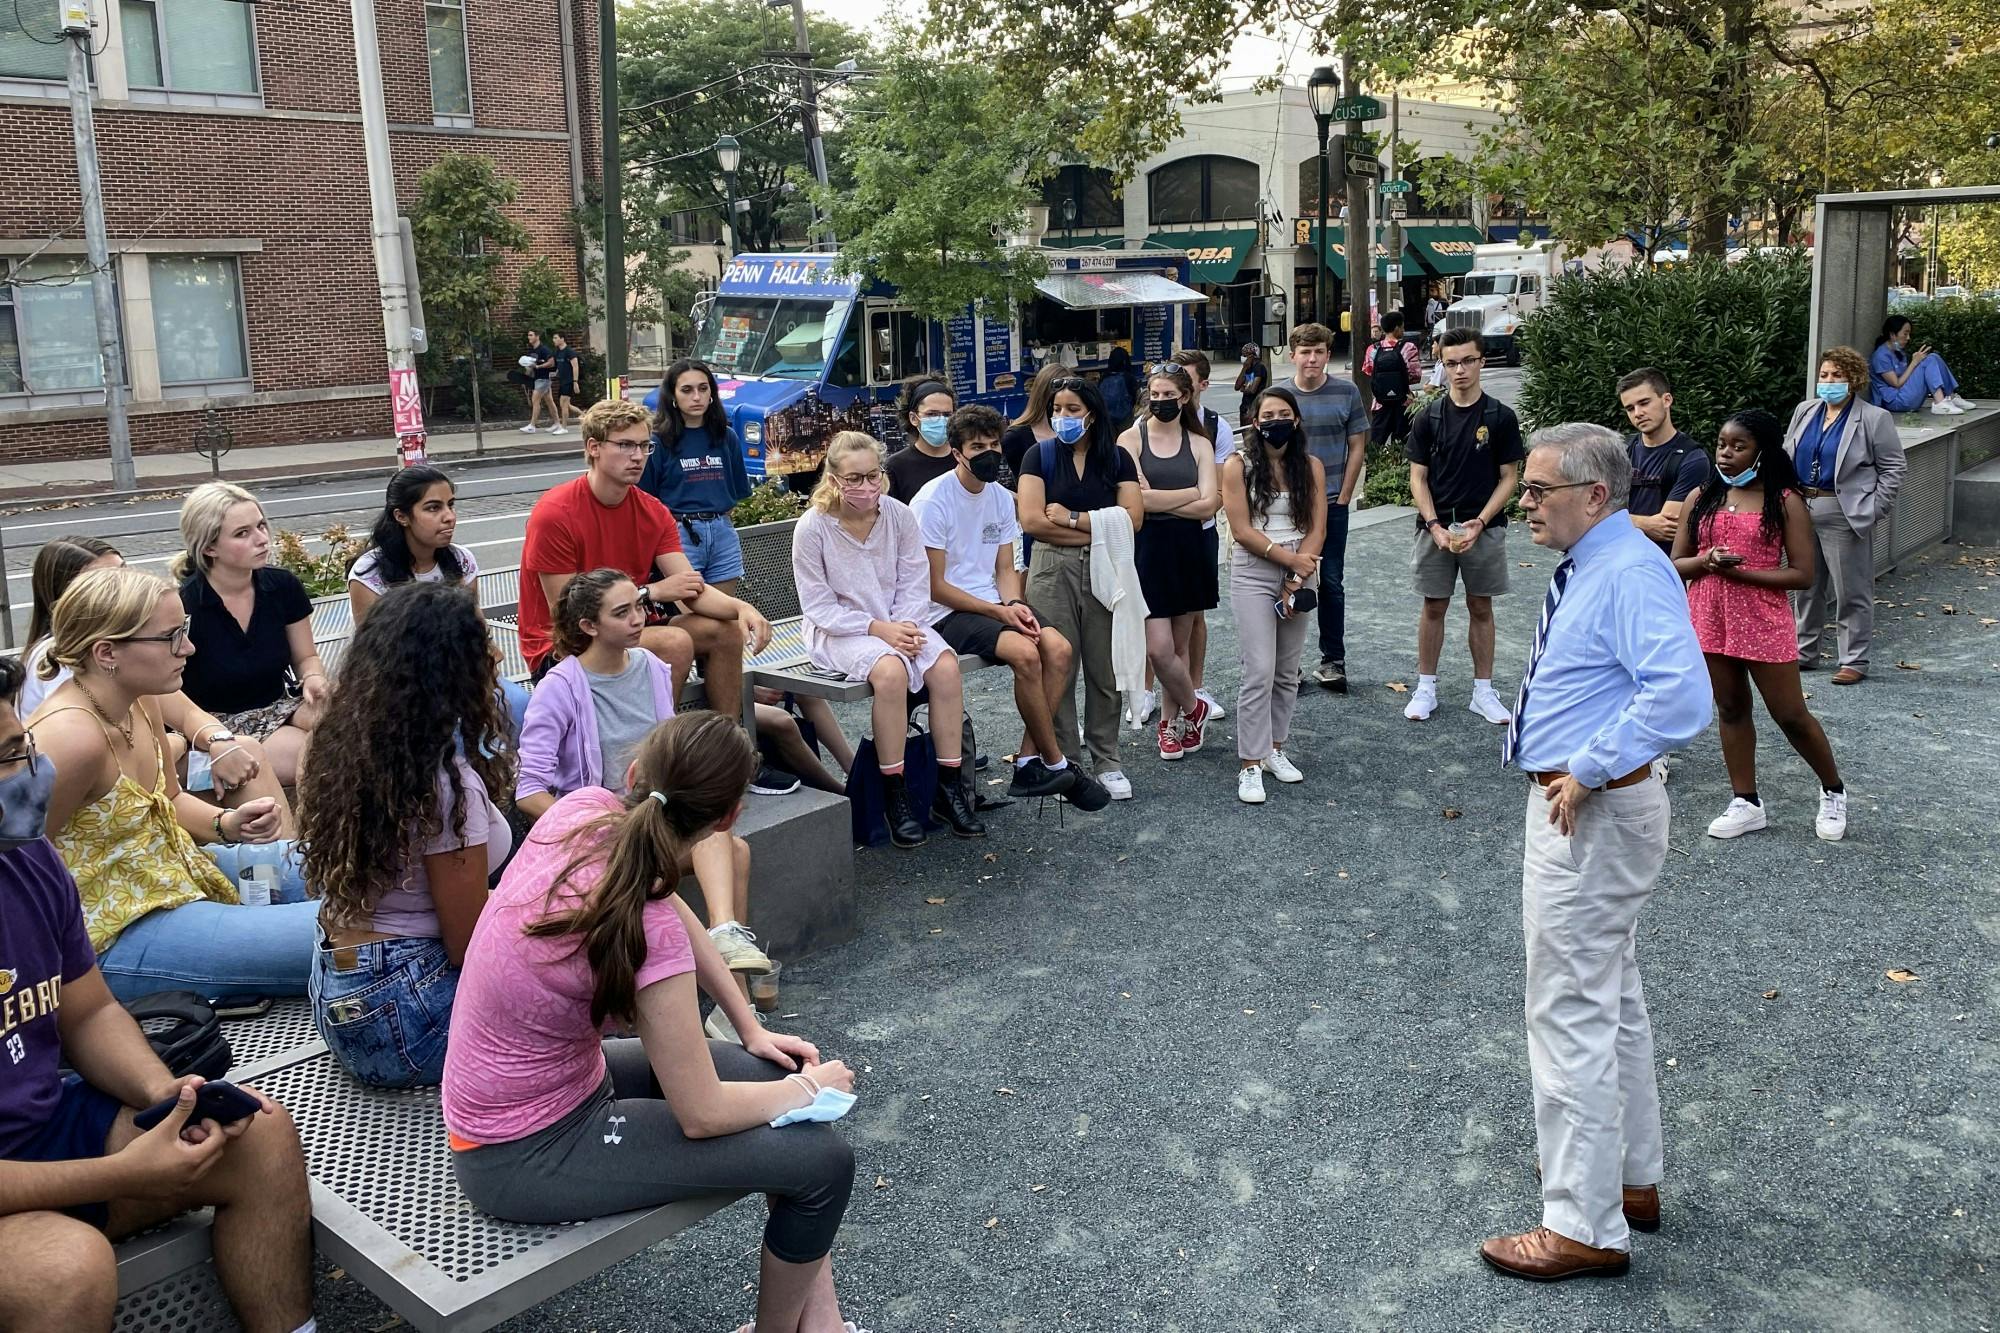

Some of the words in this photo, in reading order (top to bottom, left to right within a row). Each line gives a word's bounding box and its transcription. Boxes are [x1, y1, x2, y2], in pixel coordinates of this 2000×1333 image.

[1367, 107, 1376, 117] ST
[1187, 246, 1233, 261] OBA
[1081, 258, 1091, 268] 267
[1092, 258, 1102, 267] 474
[722, 264, 765, 284] PENN
[6, 1033, 26, 1065] 23
